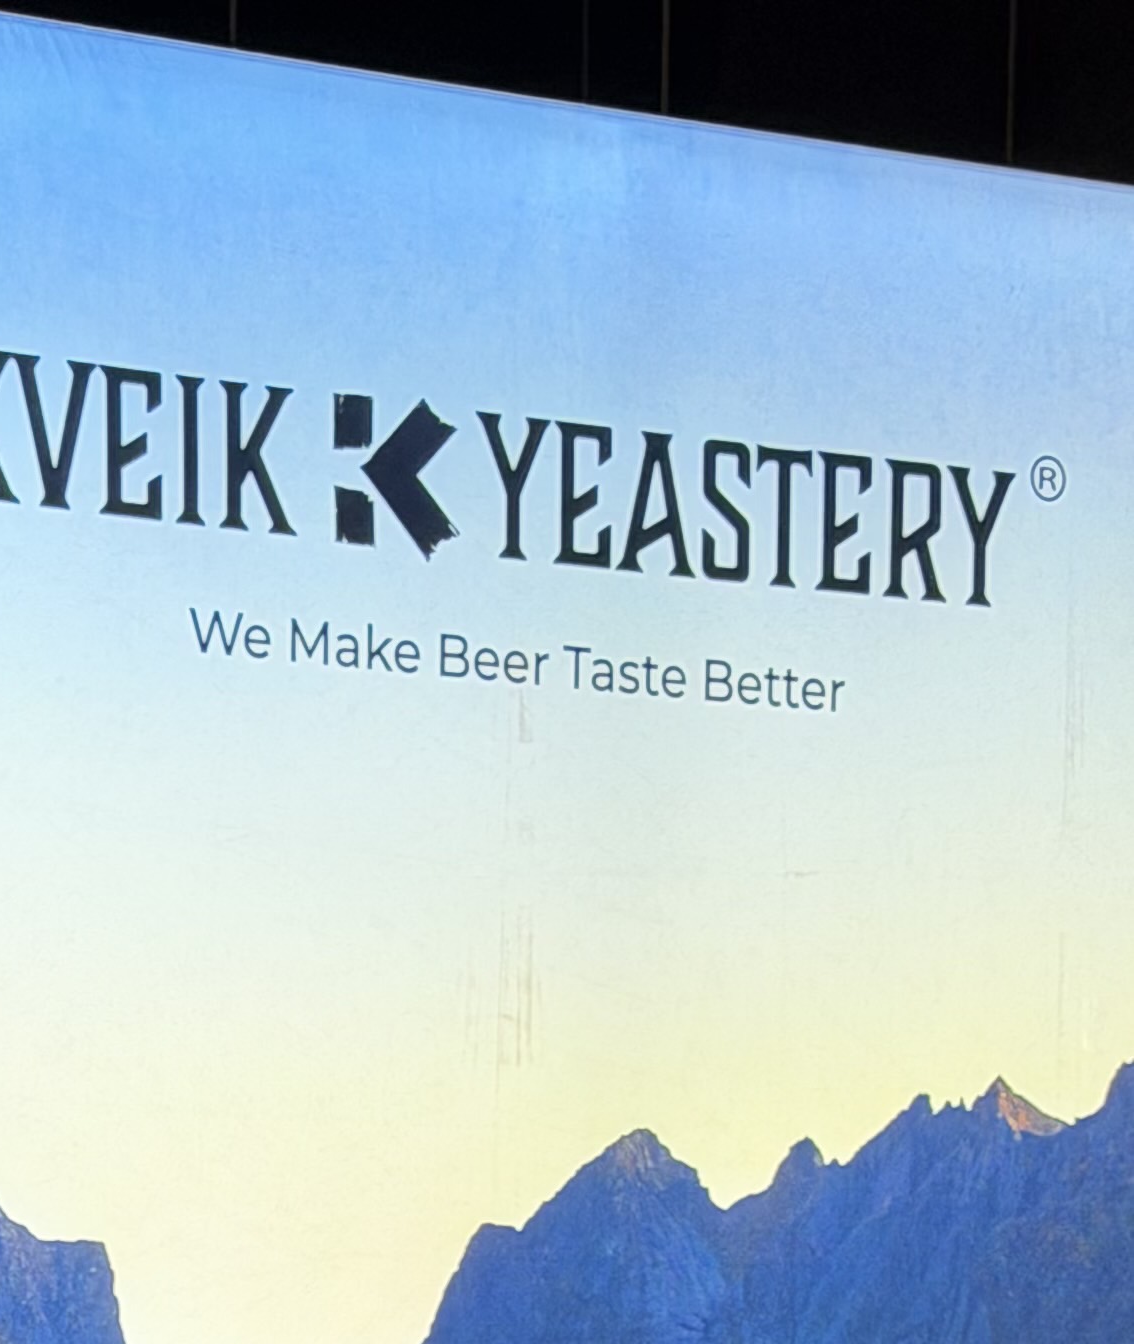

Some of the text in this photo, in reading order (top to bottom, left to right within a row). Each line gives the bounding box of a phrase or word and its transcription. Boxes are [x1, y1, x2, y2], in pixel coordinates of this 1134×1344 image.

[189, 607, 847, 714] We Make Beer Taste Better
